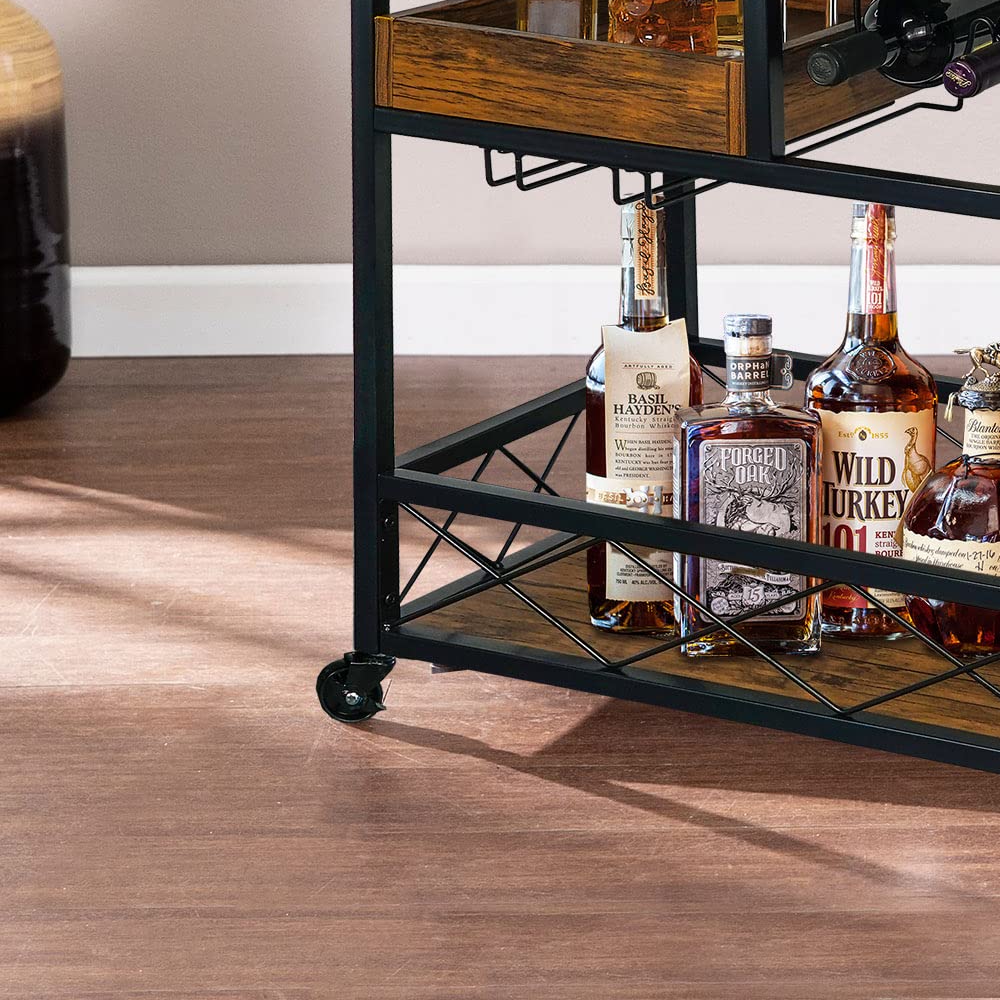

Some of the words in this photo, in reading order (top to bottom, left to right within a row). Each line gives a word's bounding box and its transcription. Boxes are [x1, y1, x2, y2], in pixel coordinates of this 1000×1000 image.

[867, 291, 882, 305] 101
[731, 370, 769, 380] BARREL
[627, 393, 669, 405] BASIL
[613, 403, 682, 416] HAYDEN'S
[719, 446, 788, 471] FORGED
[734, 464, 772, 486] OAK
[832, 450, 897, 486] WILD
[822, 481, 910, 521] TURKEY
[747, 588, 761, 602] 15
